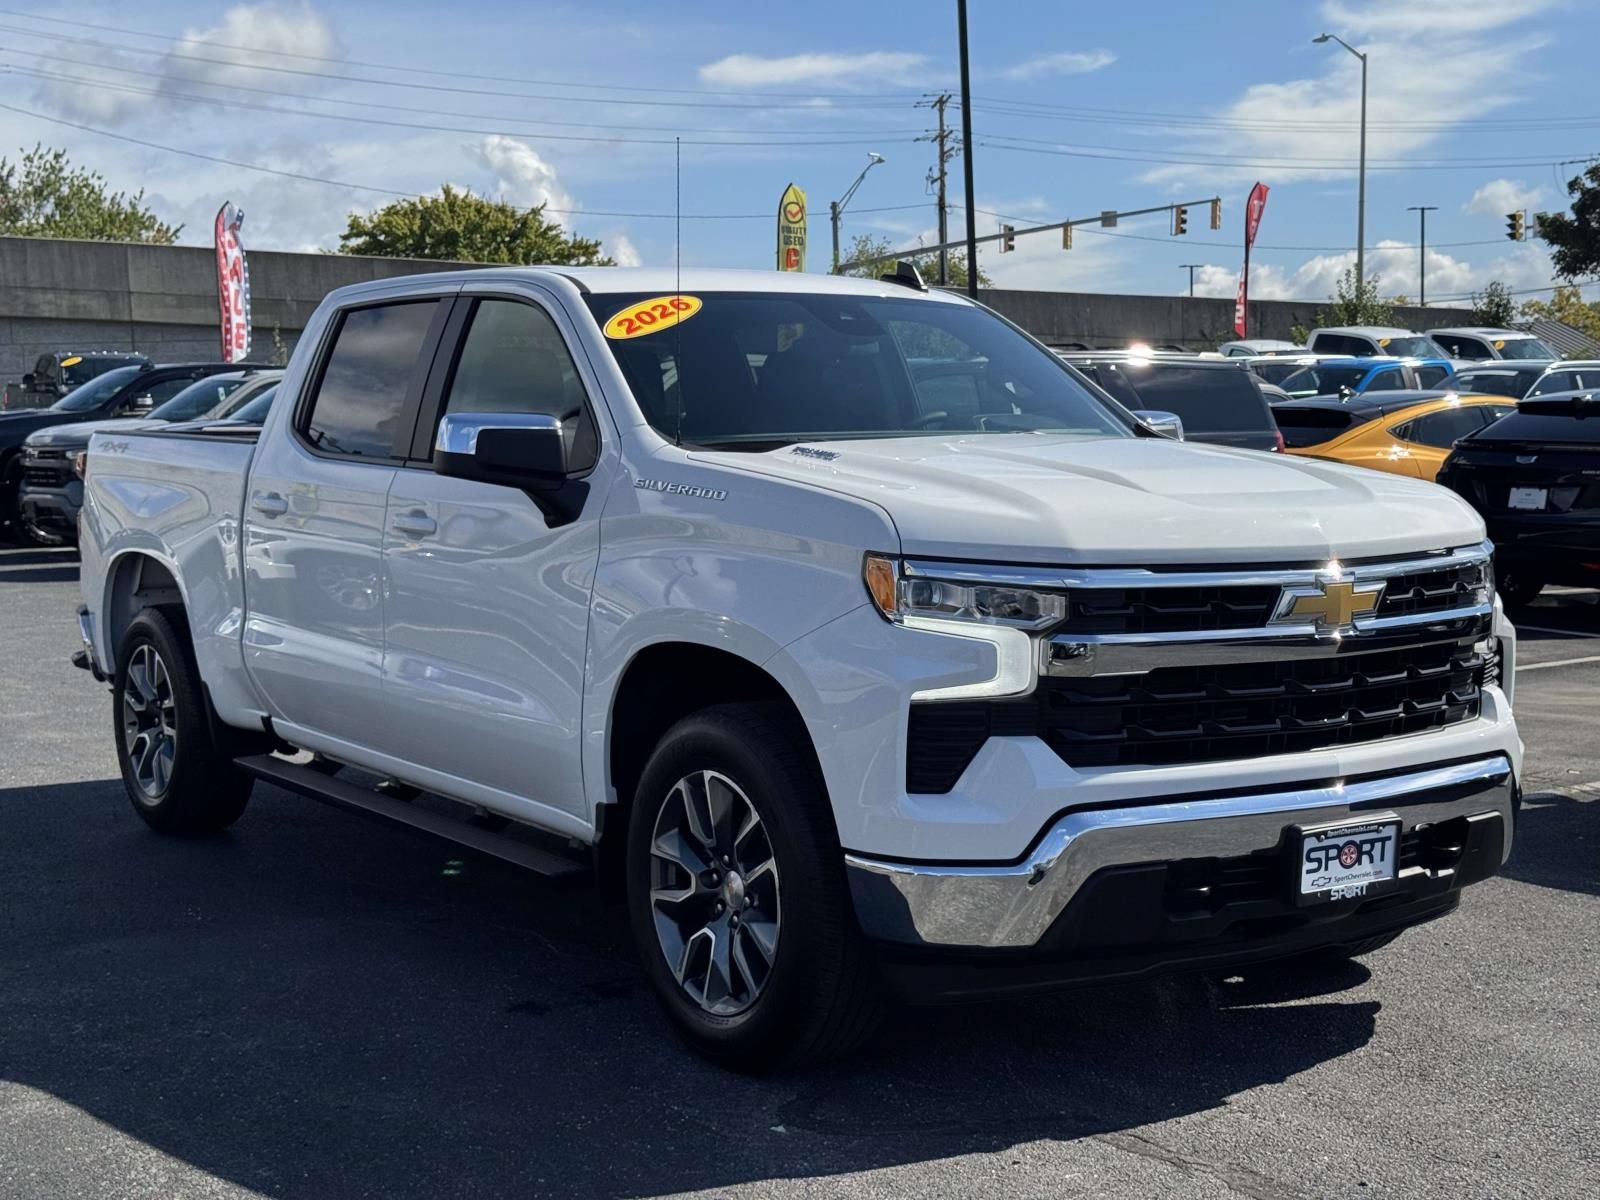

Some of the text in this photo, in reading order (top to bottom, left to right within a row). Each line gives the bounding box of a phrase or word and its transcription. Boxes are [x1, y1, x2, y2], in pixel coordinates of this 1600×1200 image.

[616, 298, 693, 336] 2026
[633, 479, 728, 501] SILVERADO
[1305, 835, 1393, 875] SPORT
[1330, 882, 1369, 901] SPORT
